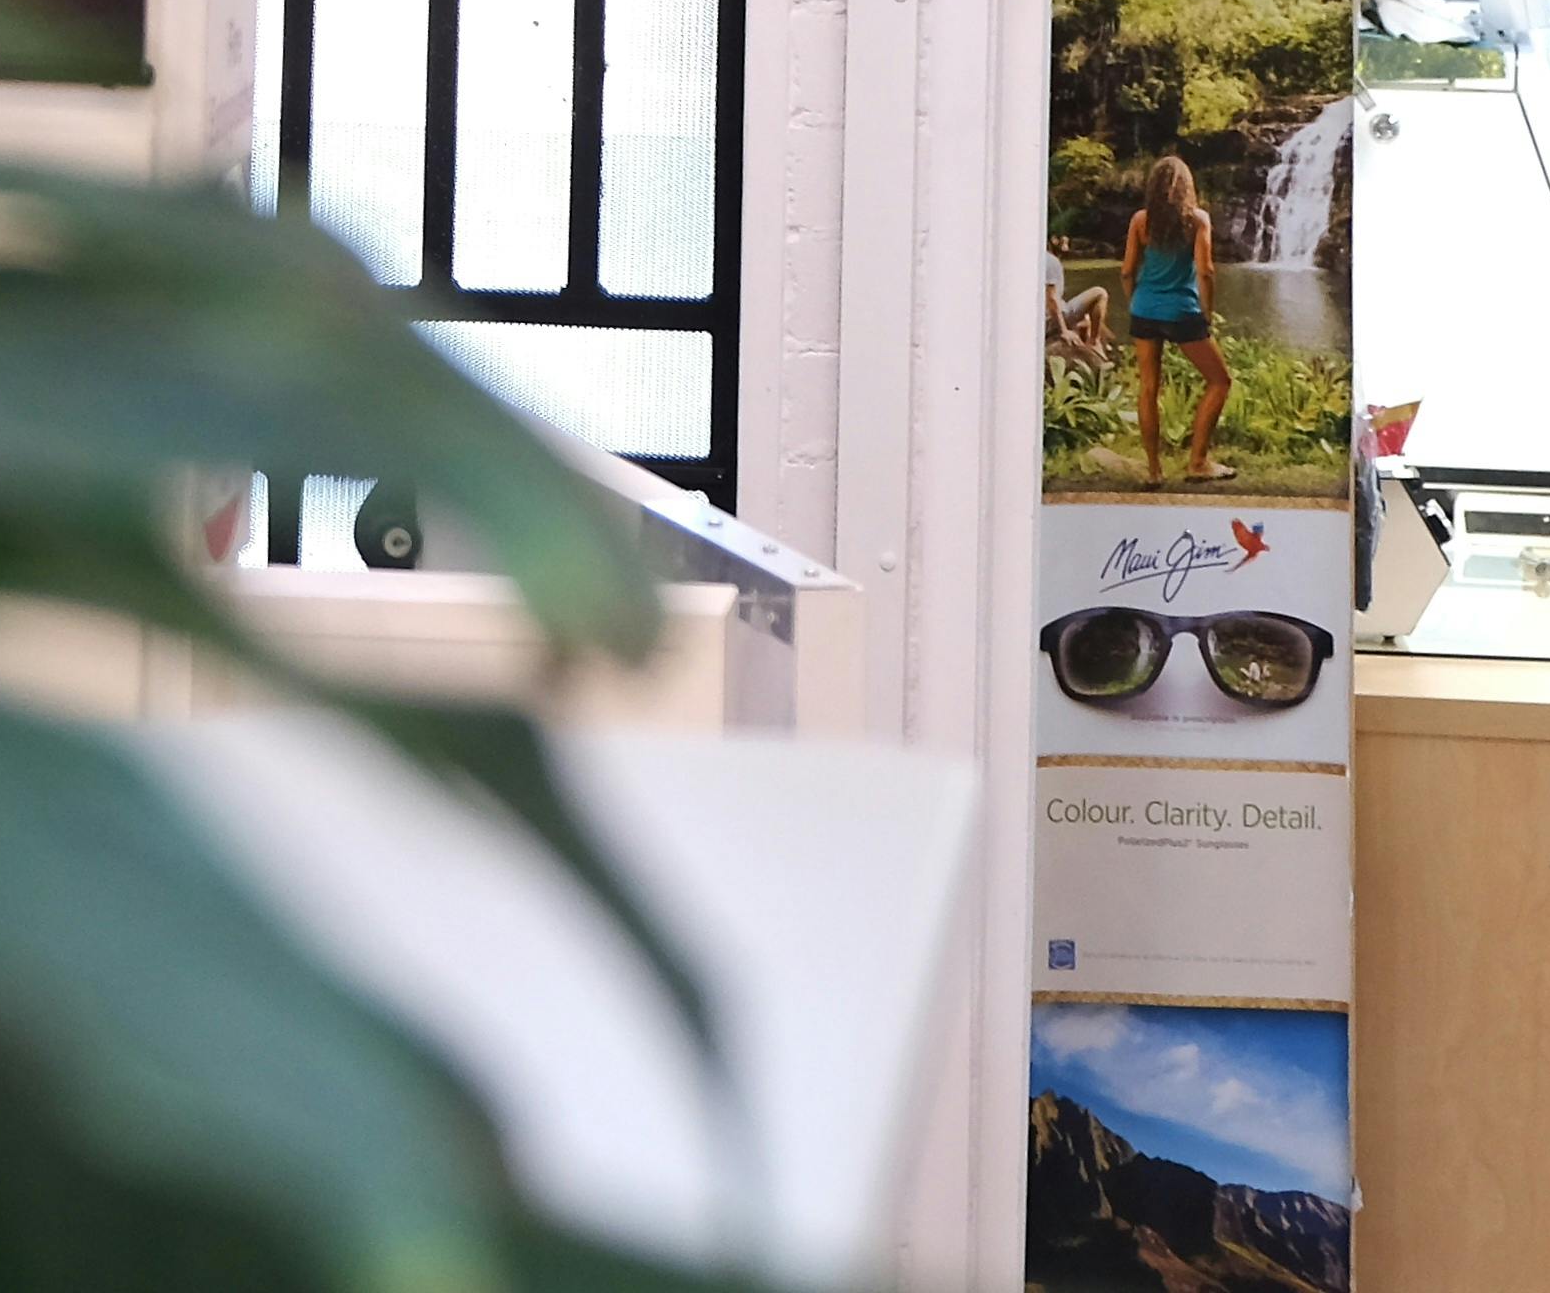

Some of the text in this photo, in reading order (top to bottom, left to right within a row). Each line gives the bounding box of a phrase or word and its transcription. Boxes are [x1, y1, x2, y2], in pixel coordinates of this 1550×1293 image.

[1100, 529, 1238, 603] Maui Jim
[1046, 798, 1322, 832] Colour. Clarity. Detail.
